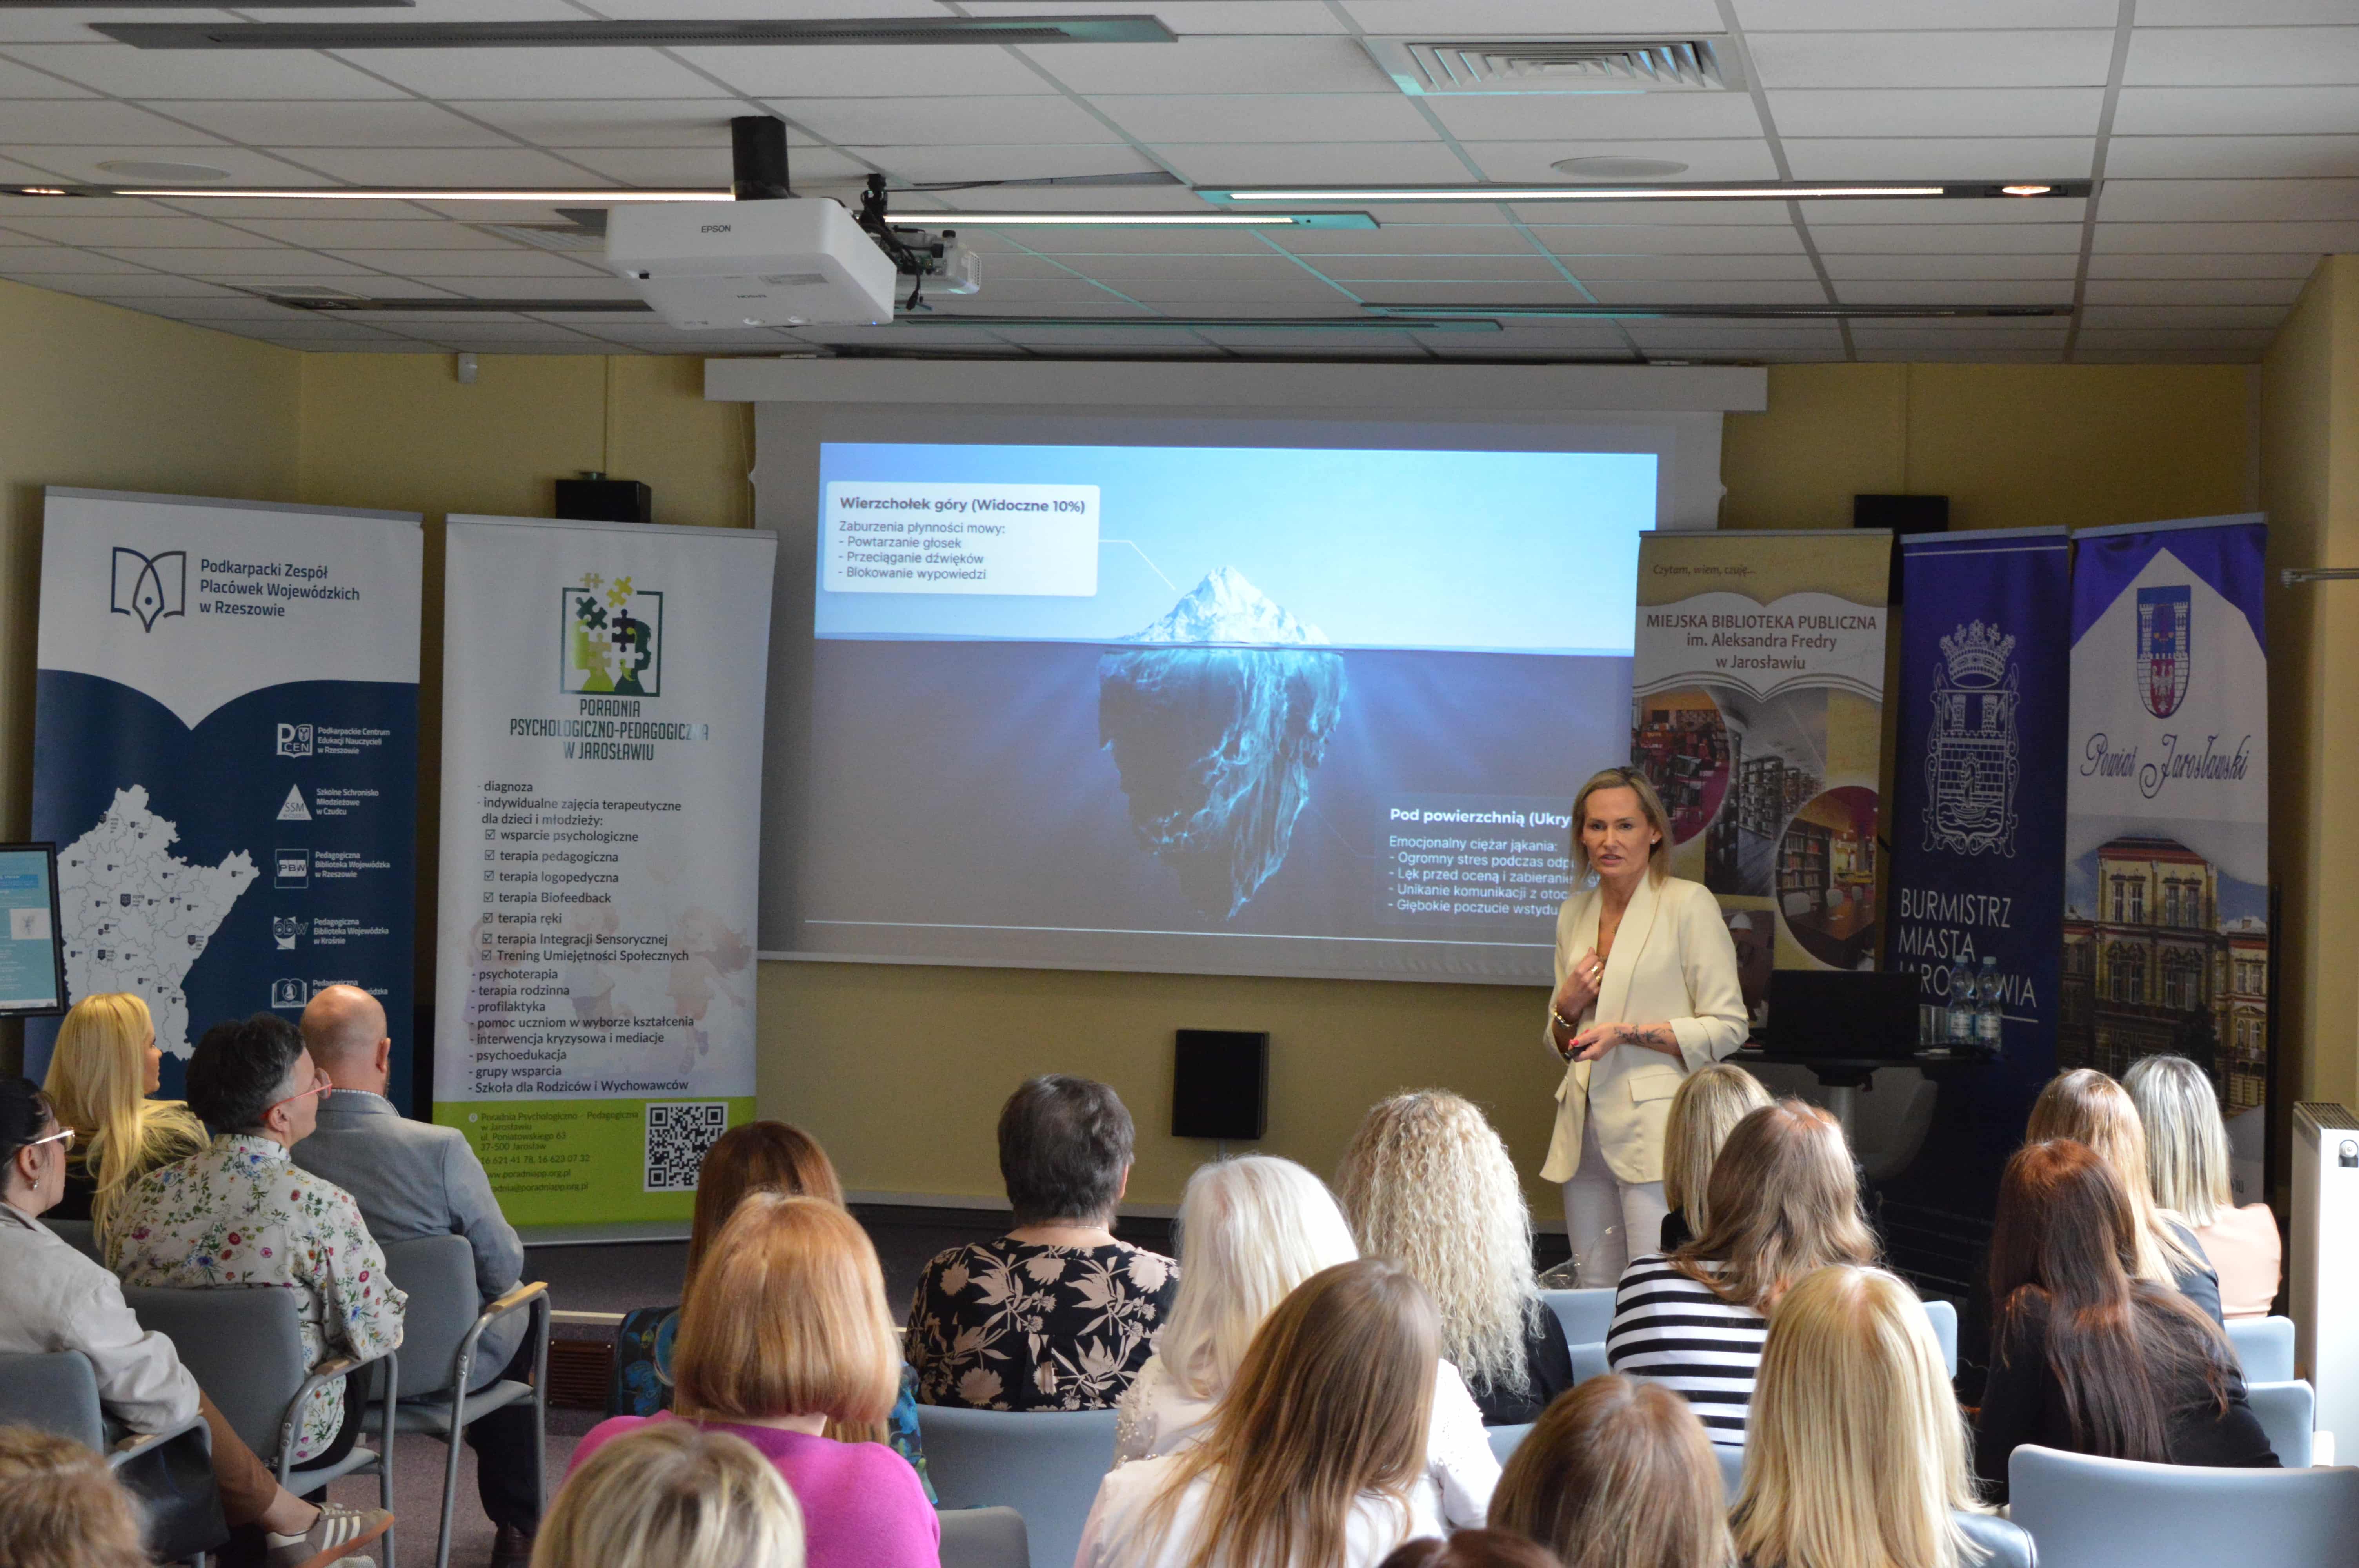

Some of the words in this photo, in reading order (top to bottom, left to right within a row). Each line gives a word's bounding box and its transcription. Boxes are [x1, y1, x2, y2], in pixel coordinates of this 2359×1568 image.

[701, 224, 731, 233] EPSON
[840, 497, 930, 510] Wierzchołek
[934, 499, 967, 512] góry
[972, 499, 1049, 512] (Widoczne
[1053, 500, 1085, 515] 10%)
[839, 521, 903, 532] Zaburzenia
[907, 521, 963, 534] płynności
[967, 523, 1005, 534] mowy:
[848, 537, 919, 548] Powtarzanie
[923, 537, 961, 550] głosek
[847, 552, 922, 564] Przeciąganie
[925, 552, 983, 566] dźwięków
[200, 559, 281, 578] Podkarpacki
[285, 564, 328, 581] Zespół
[847, 567, 913, 578] Blokowanie
[917, 568, 986, 582] wypowiedzi
[1653, 564, 1690, 577] Czytam,
[1694, 565, 1722, 576] wiem,
[200, 579, 263, 596] Placówek
[267, 582, 359, 601] Wojewódzkich
[200, 603, 211, 613] w
[215, 601, 285, 617] Rzeszowie
[1647, 614, 1707, 628] MIEJSKA
[1712, 615, 1793, 628] BIBLIOTEKA
[1798, 616, 1876, 629] PUBLICZNA
[1687, 633, 1707, 646] im.
[1712, 633, 1787, 648] Aleksandra
[1792, 635, 1836, 651] Fredry
[1716, 657, 1727, 668] w
[1731, 655, 1805, 669] Jarosławiu
[580, 699, 640, 718] PORADNIA
[318, 727, 361, 736] Podkarpackie
[510, 718, 709, 741] PSYCHOLOGICZNO-PEDAGOGICZA
[318, 737, 344, 746] Edukacji
[345, 738, 382, 746] Nauczycieli
[564, 742, 575, 759] W
[578, 742, 654, 761] JAROSŁAWIU
[484, 782, 533, 793] diagnoza
[285, 803, 305, 812] SSM
[484, 798, 558, 810] indywidualne
[561, 799, 599, 811] zajęcia
[602, 800, 681, 812] terapeutyczne
[482, 814, 498, 824] dla
[502, 815, 532, 824] dzieci
[535, 815, 538, 824] i
[542, 815, 603, 827] młodzieży:
[1390, 808, 1419, 820] Pod
[1423, 809, 1525, 826] powierzchnią
[1529, 811, 1572, 828] (Ukry
[501, 831, 549, 842] wsparcie
[553, 831, 638, 843] psychologiczne
[1390, 836, 1466, 851] Emocjonalny
[1470, 838, 1507, 850] ciężar
[1511, 840, 1557, 853] jąkania:
[315, 852, 360, 860] Pedagogiczna
[500, 851, 538, 862] terapia
[542, 851, 618, 863] pedagogiczna
[1398, 852, 1453, 866] Ogromny
[1458, 855, 1487, 866] stres
[1492, 855, 1543, 868] podczas
[1546, 857, 1575, 869] odp
[499, 872, 538, 884] terapia
[541, 872, 619, 884] logopedyczna
[1398, 867, 1418, 880] Lęk
[1423, 869, 1457, 881] przed
[1462, 870, 1499, 884] oceną
[1503, 871, 1505, 882] i
[499, 893, 538, 904] terapia
[542, 892, 611, 903] Biofeedback
[1398, 885, 1450, 895] Unikanie
[1454, 886, 1526, 900] komunikacji
[1530, 889, 1536, 898] z
[1397, 900, 1450, 913] Głębokie
[1454, 902, 1508, 914] poczucie
[1513, 904, 1558, 916] wstydu
[1901, 888, 2011, 929] BURMISTRZ
[314, 918, 359, 927] Pedagogiczna
[498, 913, 537, 924] terapia
[541, 913, 562, 926] ręki
[497, 934, 536, 945] terapia
[540, 933, 592, 946] Integracji
[596, 934, 668, 946] Sensorycznej
[1899, 926, 1976, 962] MIASTA
[497, 951, 540, 962] Trening
[543, 951, 617, 963] Umiejętności
[620, 951, 689, 962] Społecznych
[479, 969, 558, 981] psychoterapia
[479, 985, 517, 997] terapia
[520, 985, 569, 995] rodzinna
[478, 1001, 545, 1013] profilaktyka
[477, 1019, 515, 1030] pomoc
[518, 1018, 566, 1028] uczniom
[583, 1017, 630, 1030] wyborze
[633, 1017, 694, 1027] kształcenia
[477, 1034, 543, 1046] interwencja
[547, 1033, 606, 1045] kryzysowa
[609, 1033, 612, 1043] i
[616, 1033, 664, 1045] mediacje
[476, 1050, 567, 1062] psychoedukacja
[476, 1068, 508, 1079] grupy
[512, 1066, 562, 1078] wsparcia
[475, 1082, 513, 1093] Szkoła
[516, 1082, 533, 1092] dla
[537, 1081, 591, 1092] Rodziców
[594, 1081, 598, 1091] i
[601, 1080, 688, 1092] Wychowawców
[518, 1113, 577, 1121] Psychologiczno
[492, 1133, 554, 1141] Poniatowskiego
[487, 1169, 571, 1179] ww.poradniapp.org.pl
